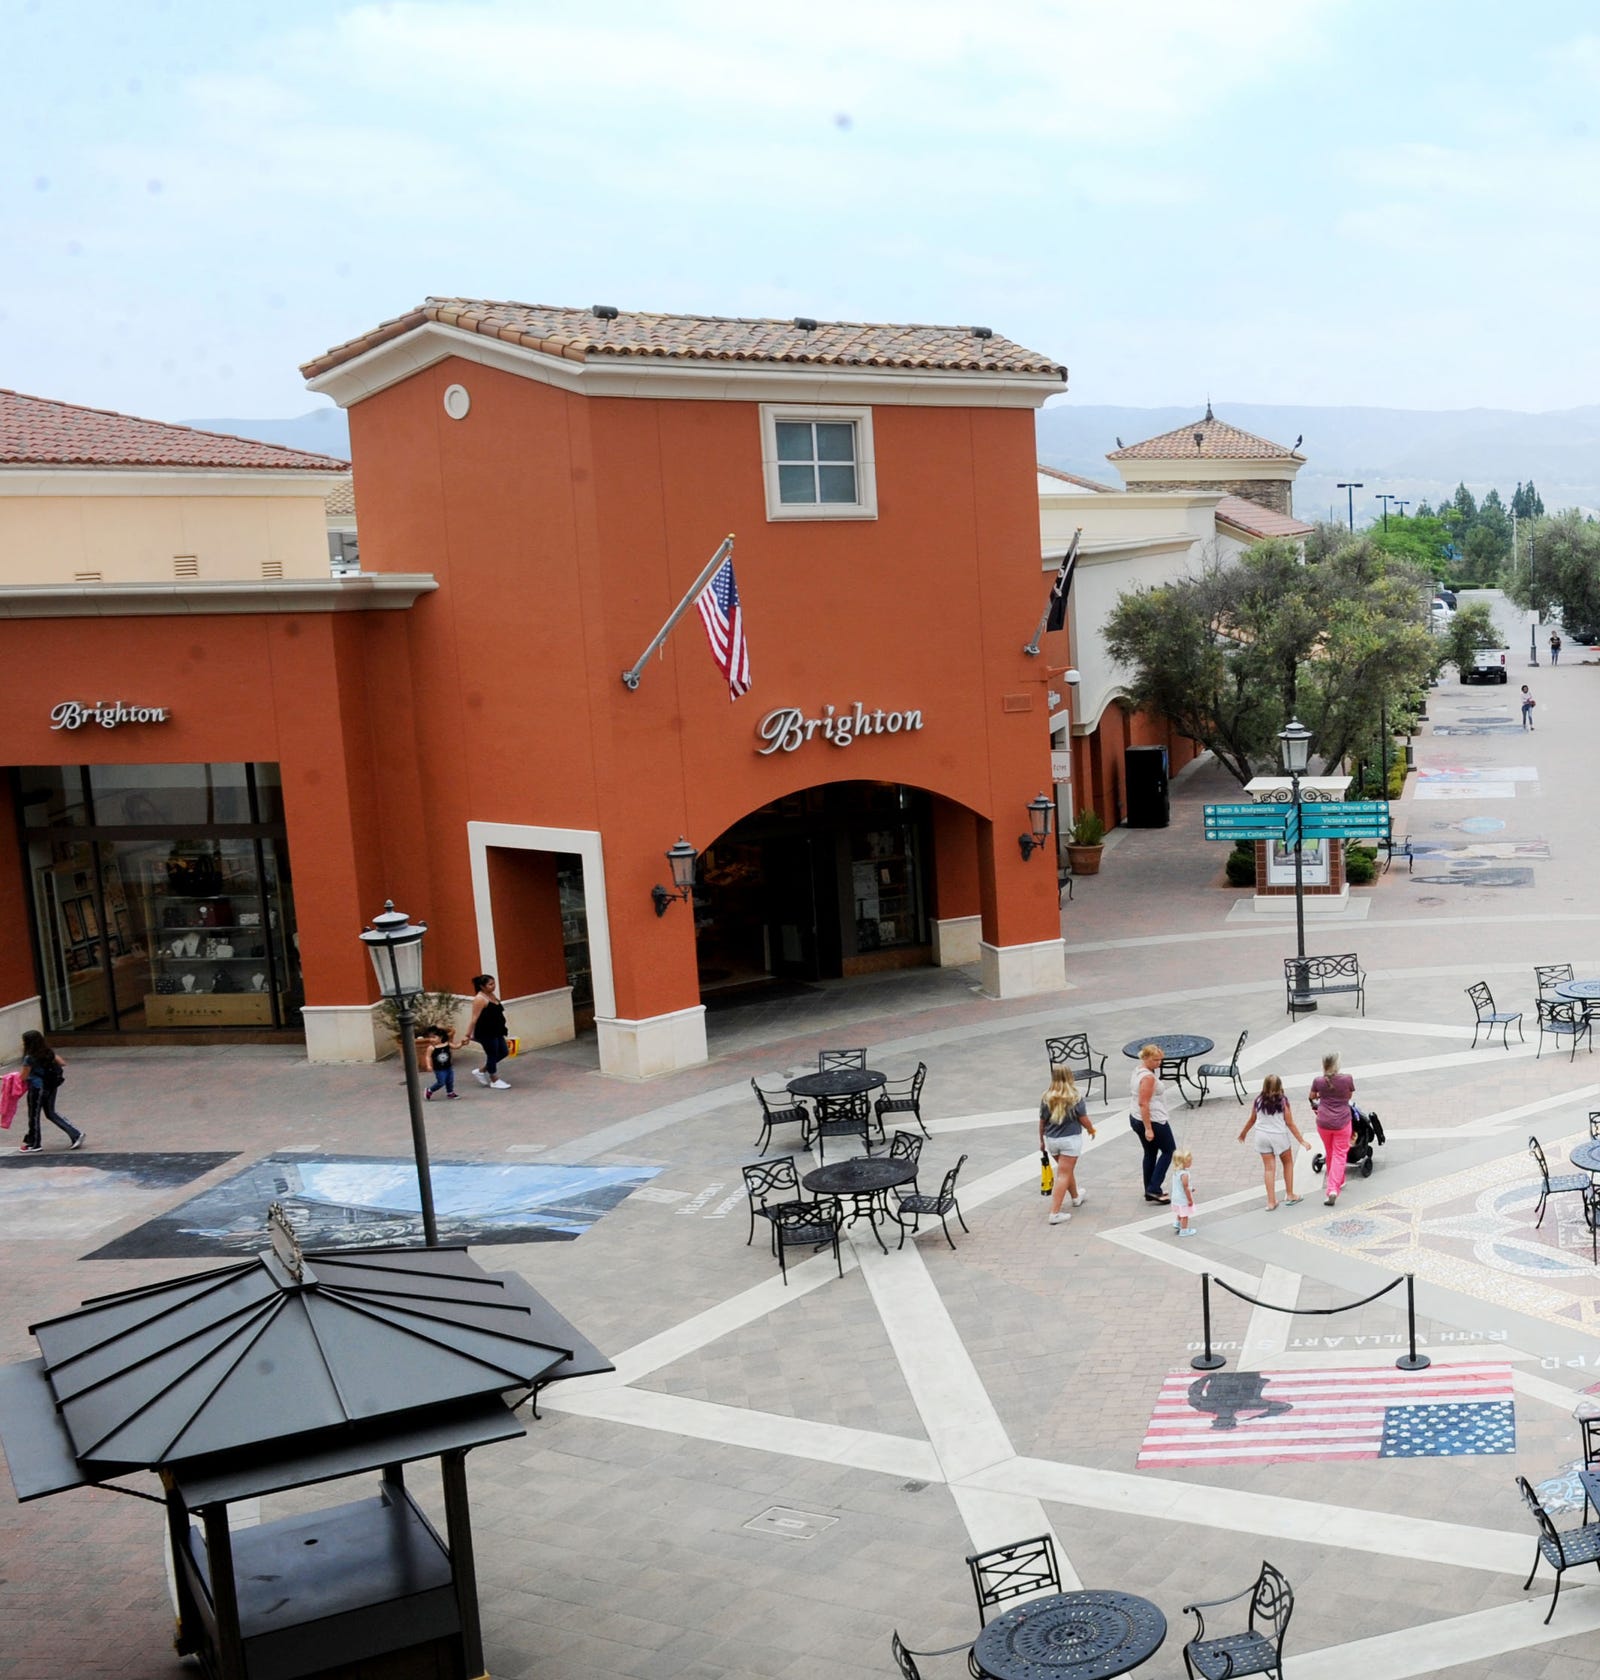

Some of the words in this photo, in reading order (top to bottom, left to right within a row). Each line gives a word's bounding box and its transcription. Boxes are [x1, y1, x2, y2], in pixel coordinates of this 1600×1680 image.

[49, 700, 167, 730] Brighton
[757, 701, 924, 755] Brighton
[1217, 806, 1233, 814] Bath
